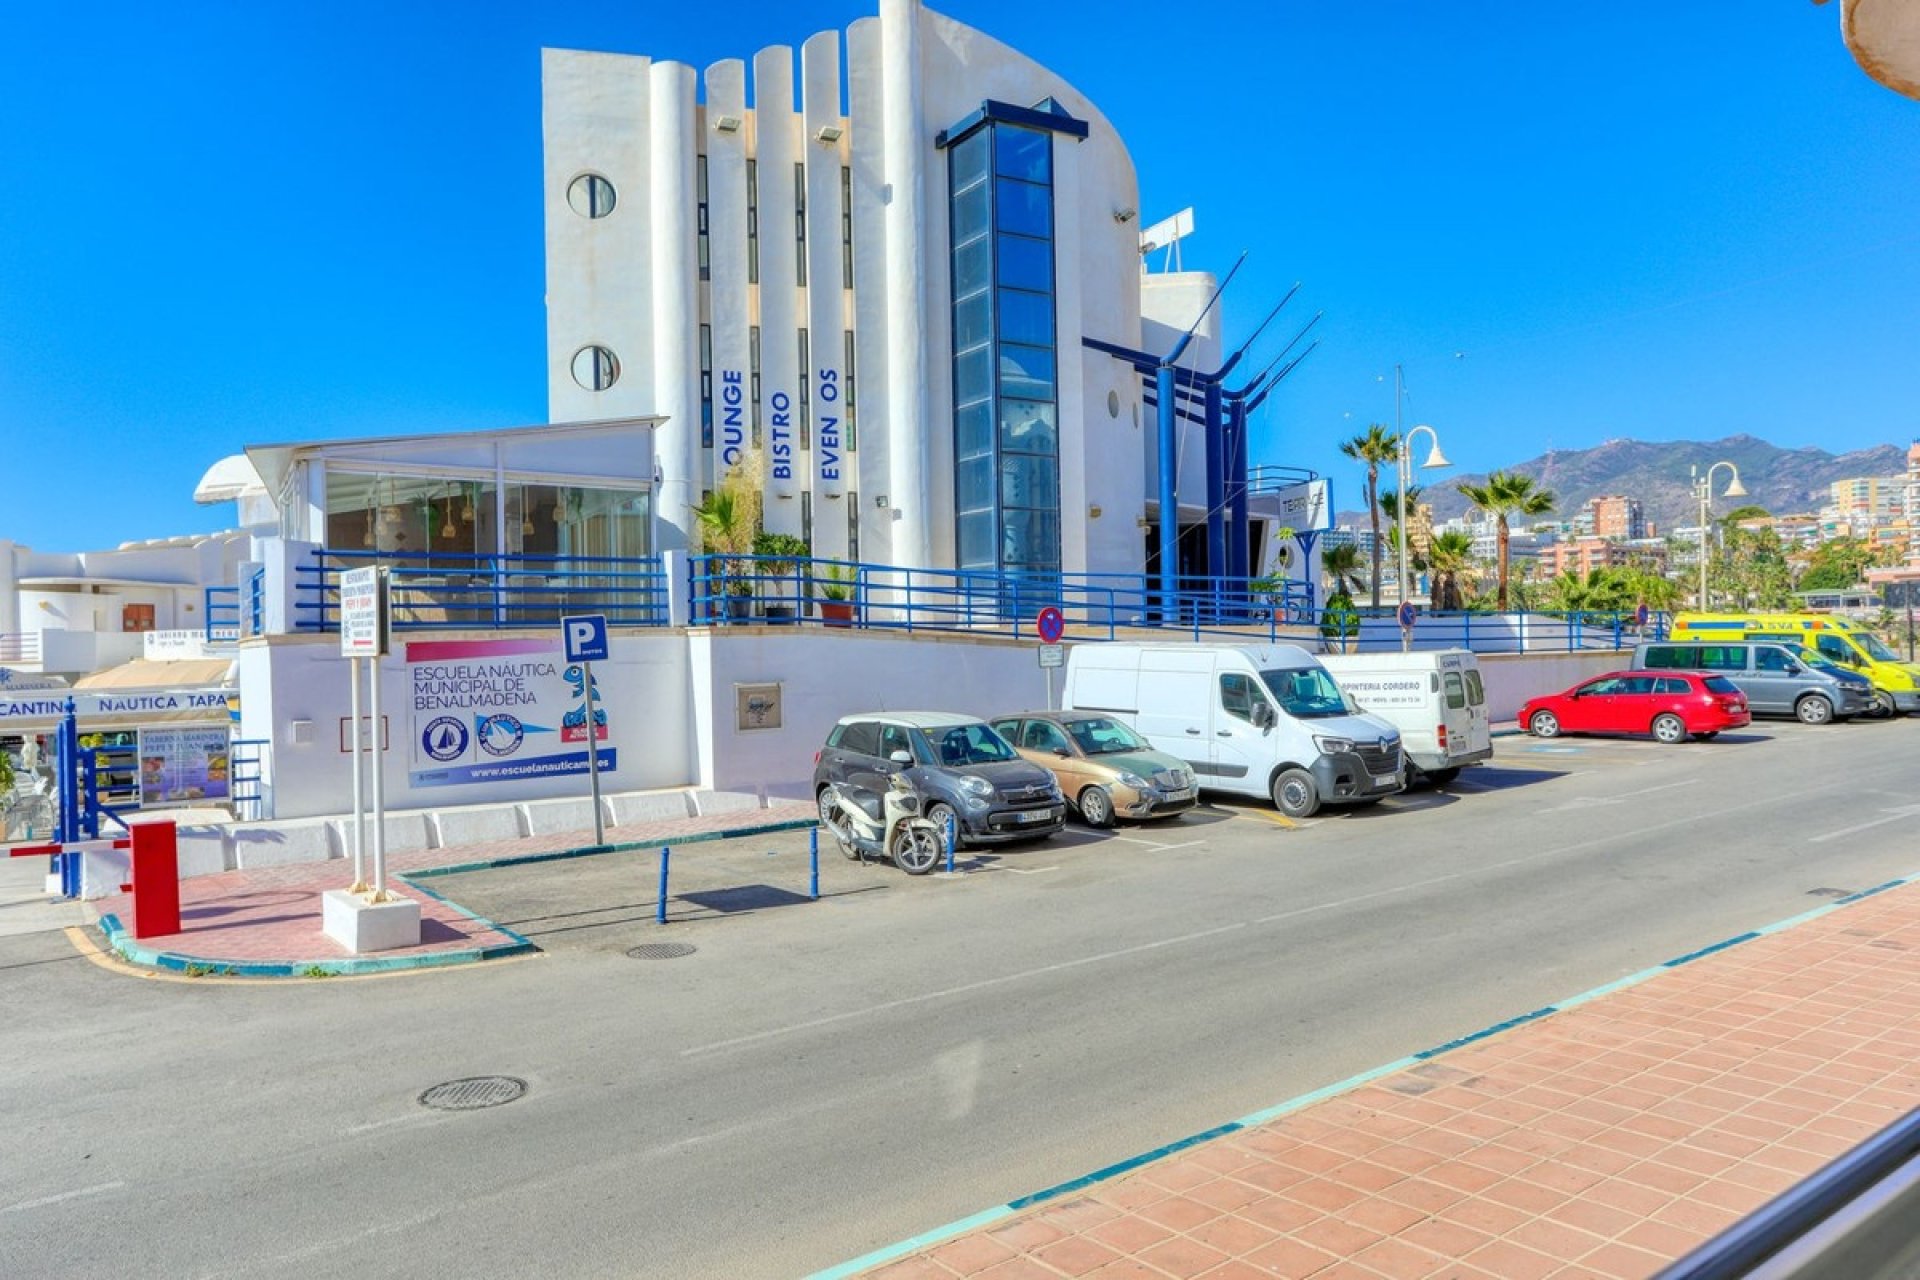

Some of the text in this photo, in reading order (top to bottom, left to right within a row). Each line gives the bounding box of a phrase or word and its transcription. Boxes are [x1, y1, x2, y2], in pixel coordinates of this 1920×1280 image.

[819, 368, 839, 481] EVEN OS
[771, 391, 791, 480] BISTRO
[569, 622, 595, 656] P
[414, 660, 557, 681] ESCUELA NÁUTICA
[414, 678, 525, 695] MUNICIPAL DE
[100, 696, 178, 712] NAUTICA
[414, 692, 537, 710] BENALMADENA
